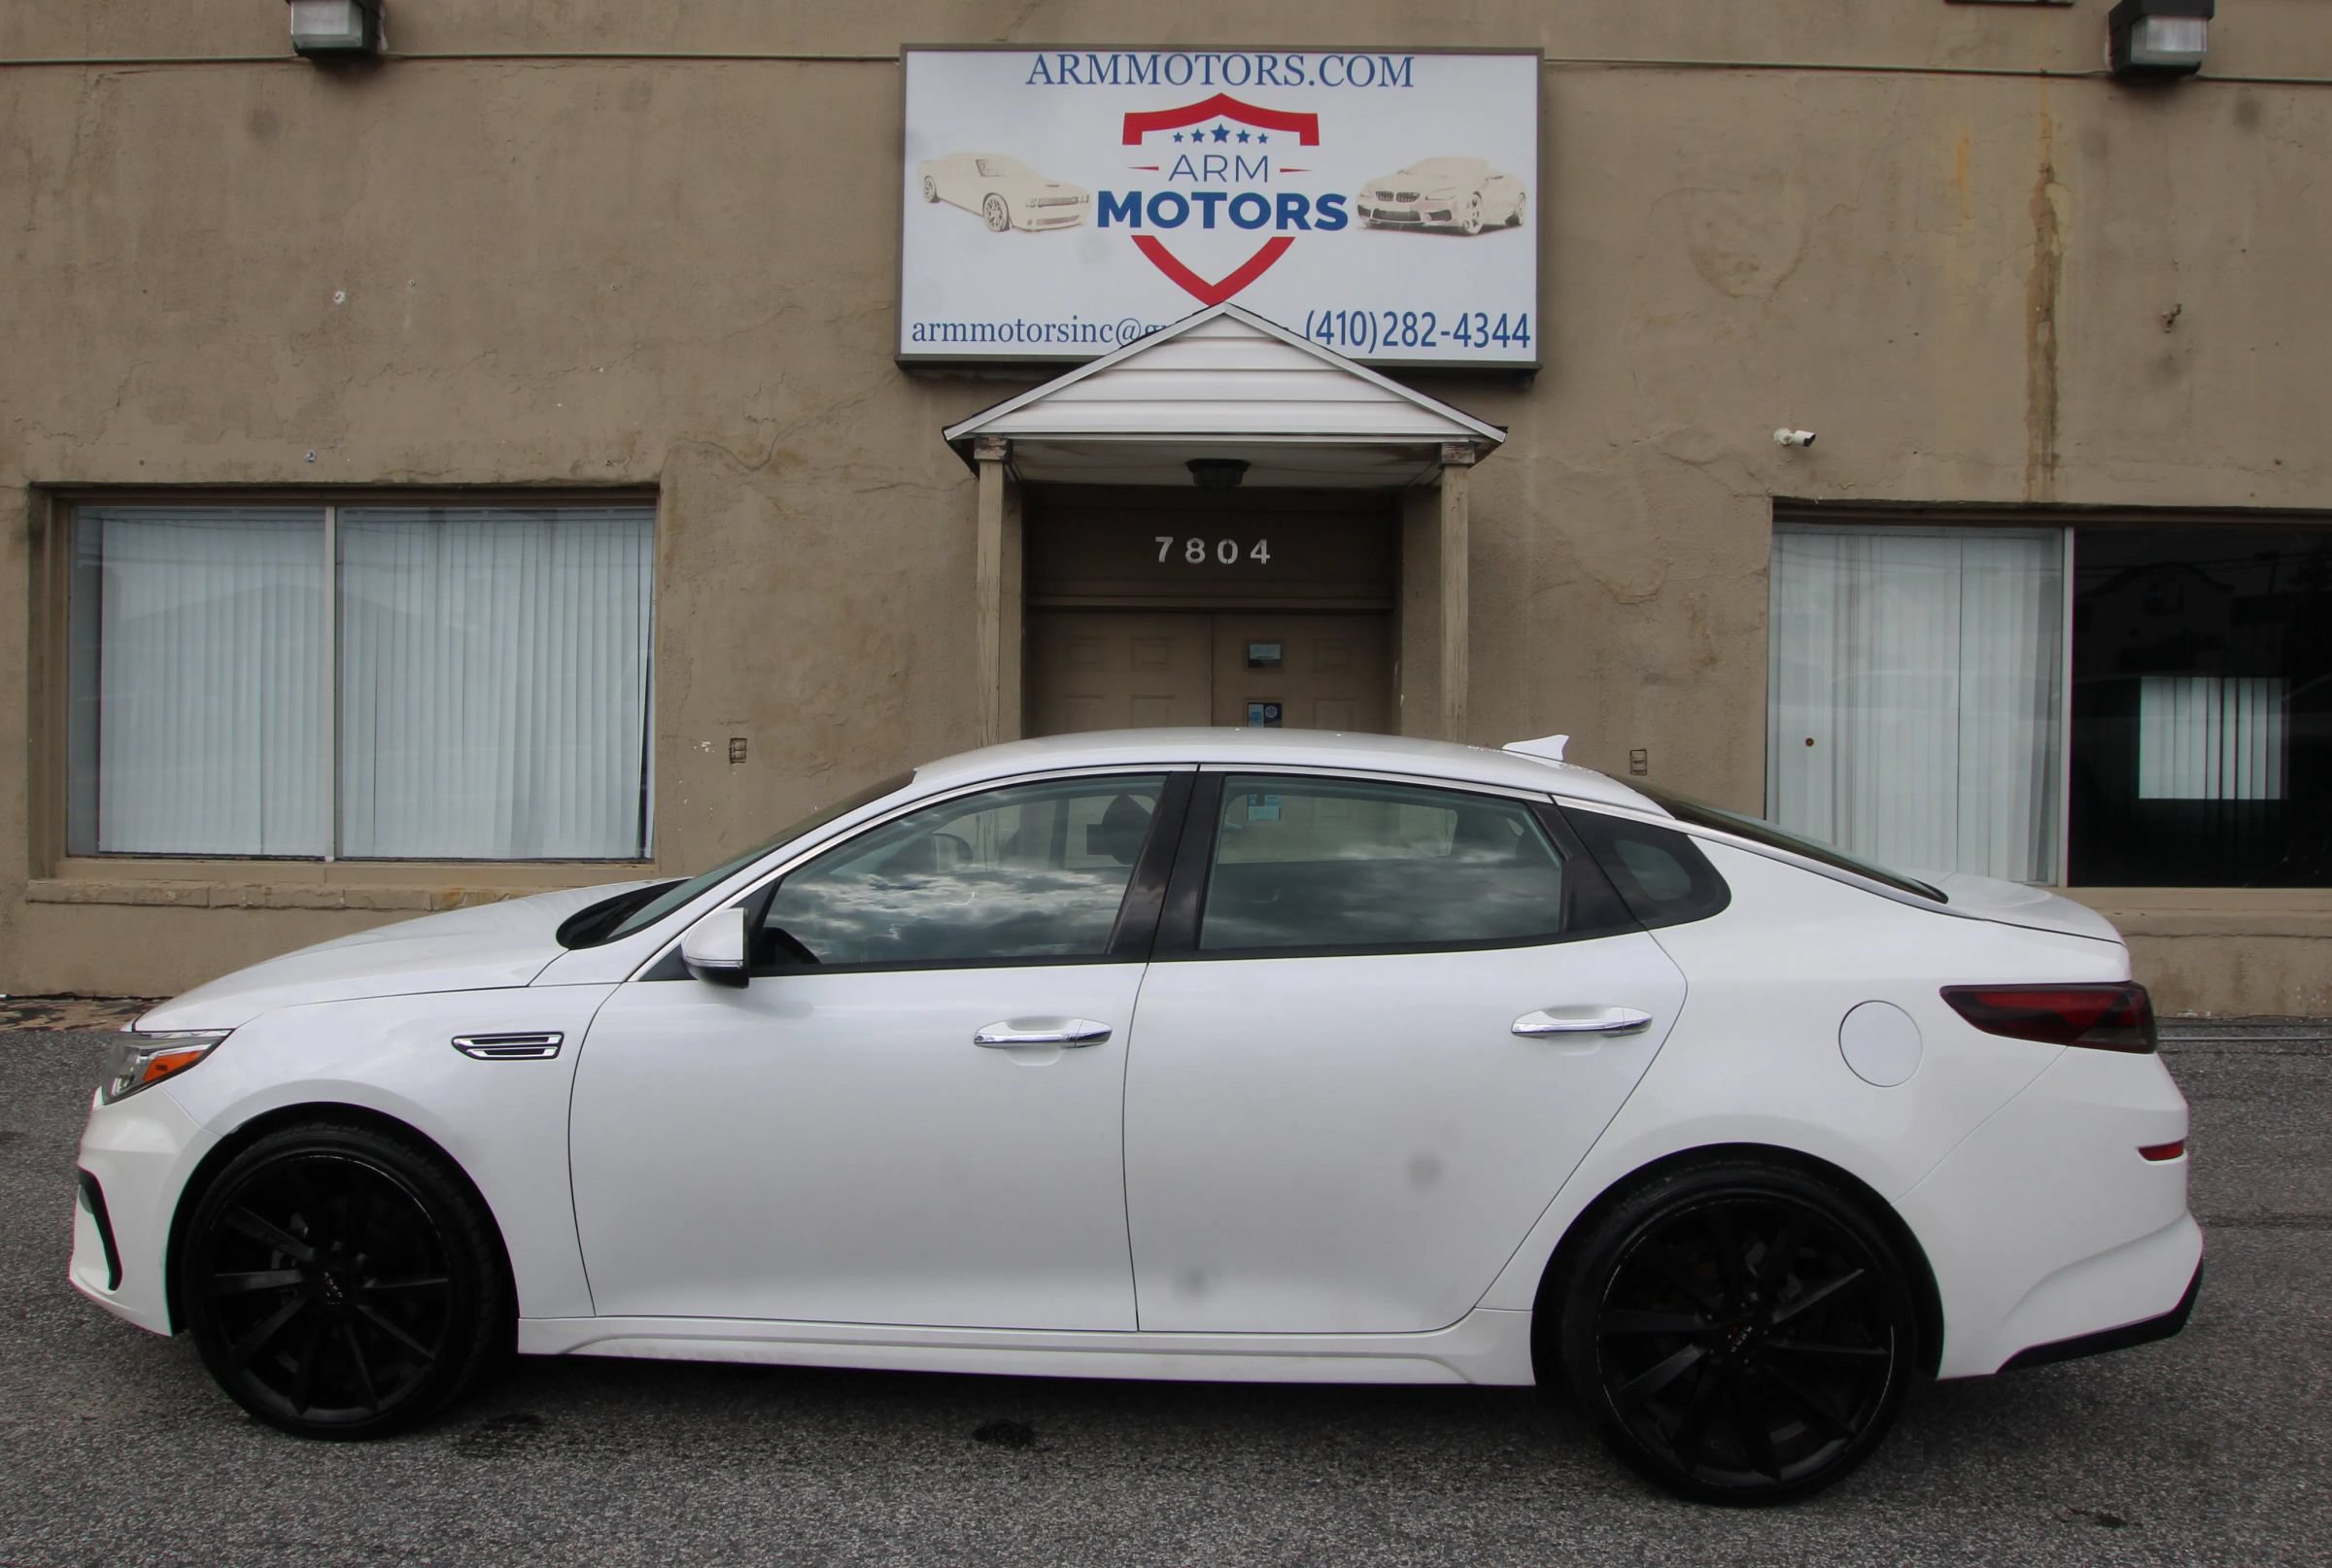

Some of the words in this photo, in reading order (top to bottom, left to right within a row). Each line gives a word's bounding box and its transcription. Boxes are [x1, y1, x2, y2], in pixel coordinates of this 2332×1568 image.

[1025, 52, 1415, 88] ARMMOTORS.COM
[1168, 154, 1269, 183] ARM
[1097, 189, 1349, 232] MOTORS
[1305, 309, 1531, 354] (410)282-4344
[1154, 535, 1271, 565] 7804
